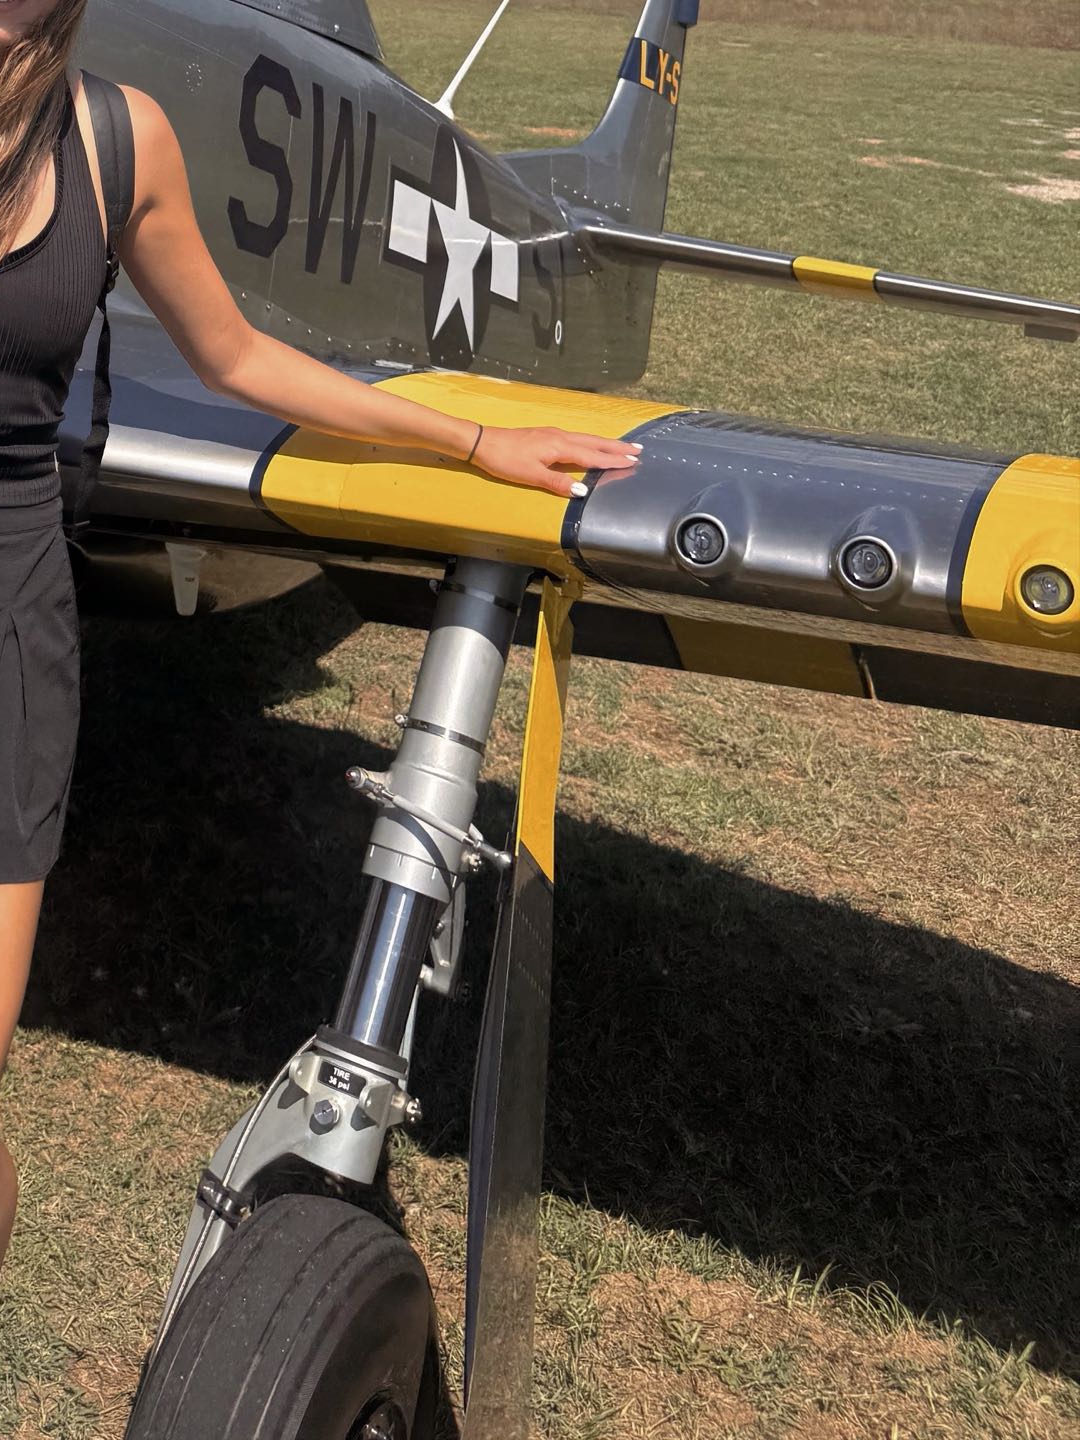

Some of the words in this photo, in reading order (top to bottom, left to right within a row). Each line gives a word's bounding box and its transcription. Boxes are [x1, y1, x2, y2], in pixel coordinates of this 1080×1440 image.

[227, 54, 376, 285] SW
[333, 1067, 350, 1081] TIRE
[338, 1081, 350, 1091] psi
